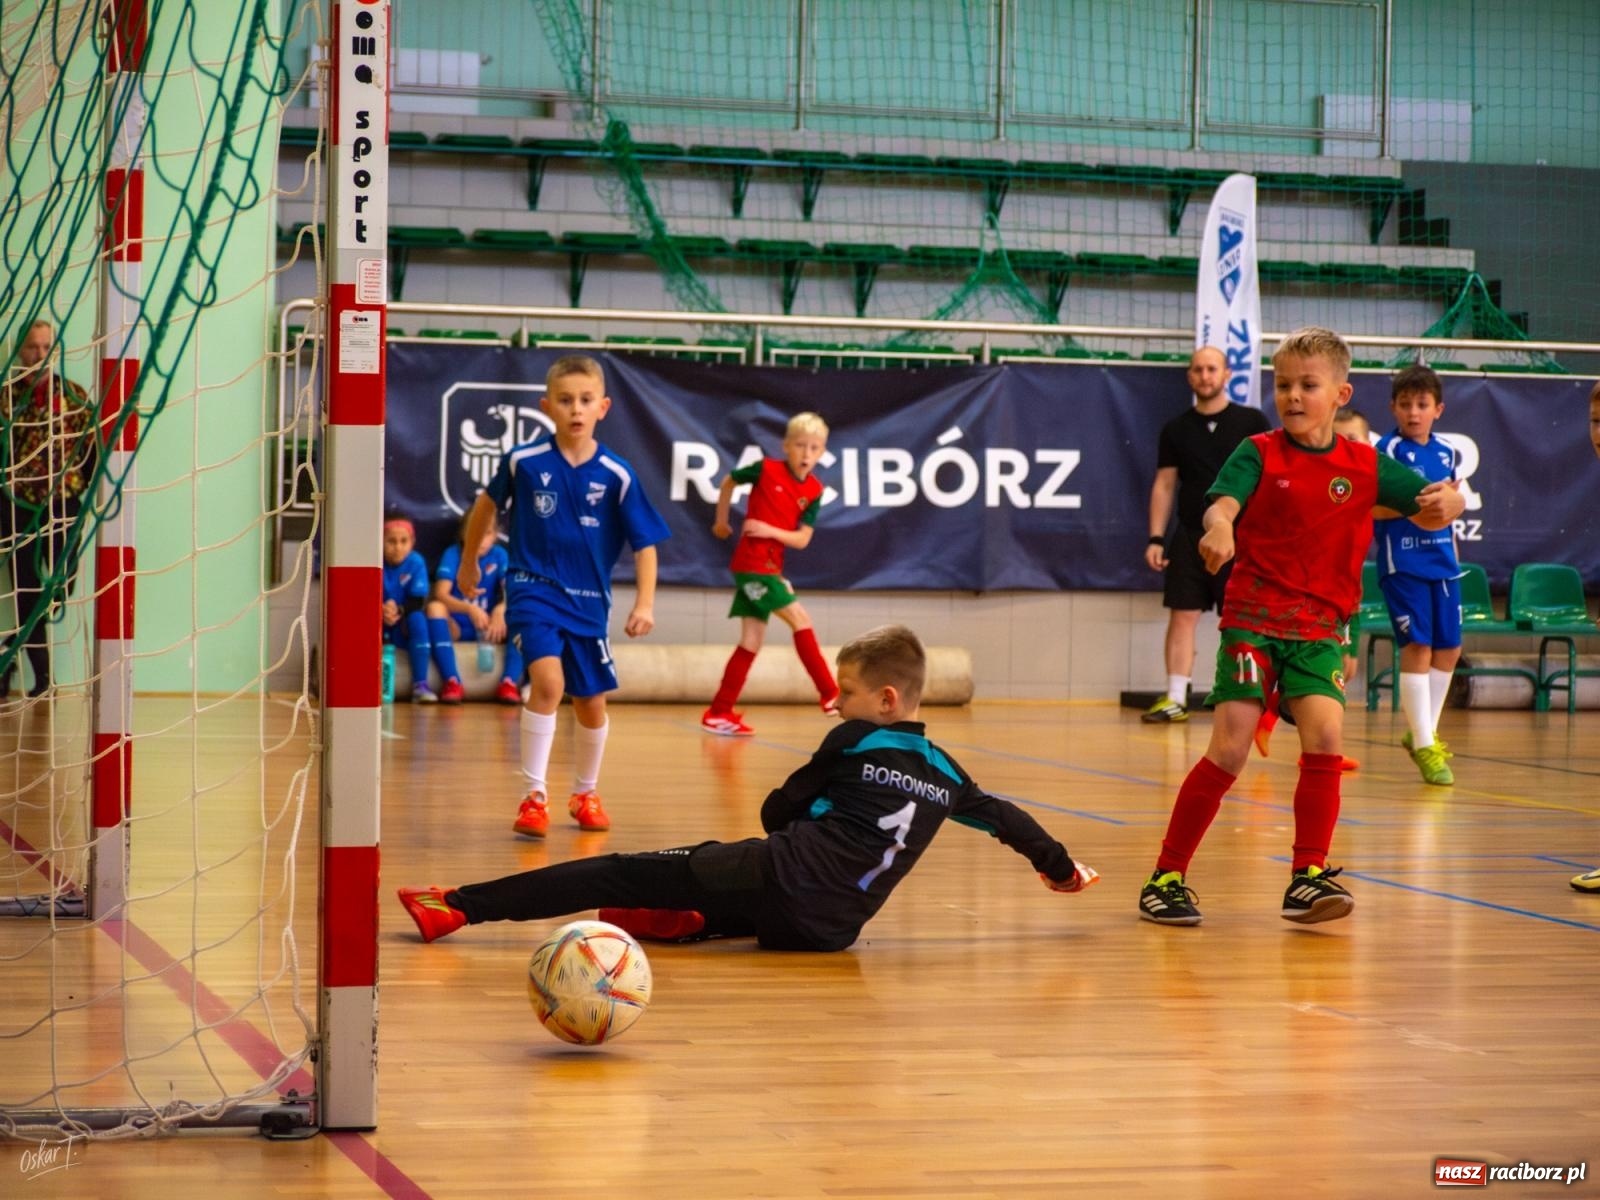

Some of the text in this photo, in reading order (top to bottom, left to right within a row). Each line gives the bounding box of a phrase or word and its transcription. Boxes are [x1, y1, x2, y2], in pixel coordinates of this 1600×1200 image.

[352, 0, 380, 243] oma sport
[1236, 651, 1258, 684] 11
[862, 763, 950, 806] BOROWSKI
[857, 800, 917, 892] 1
